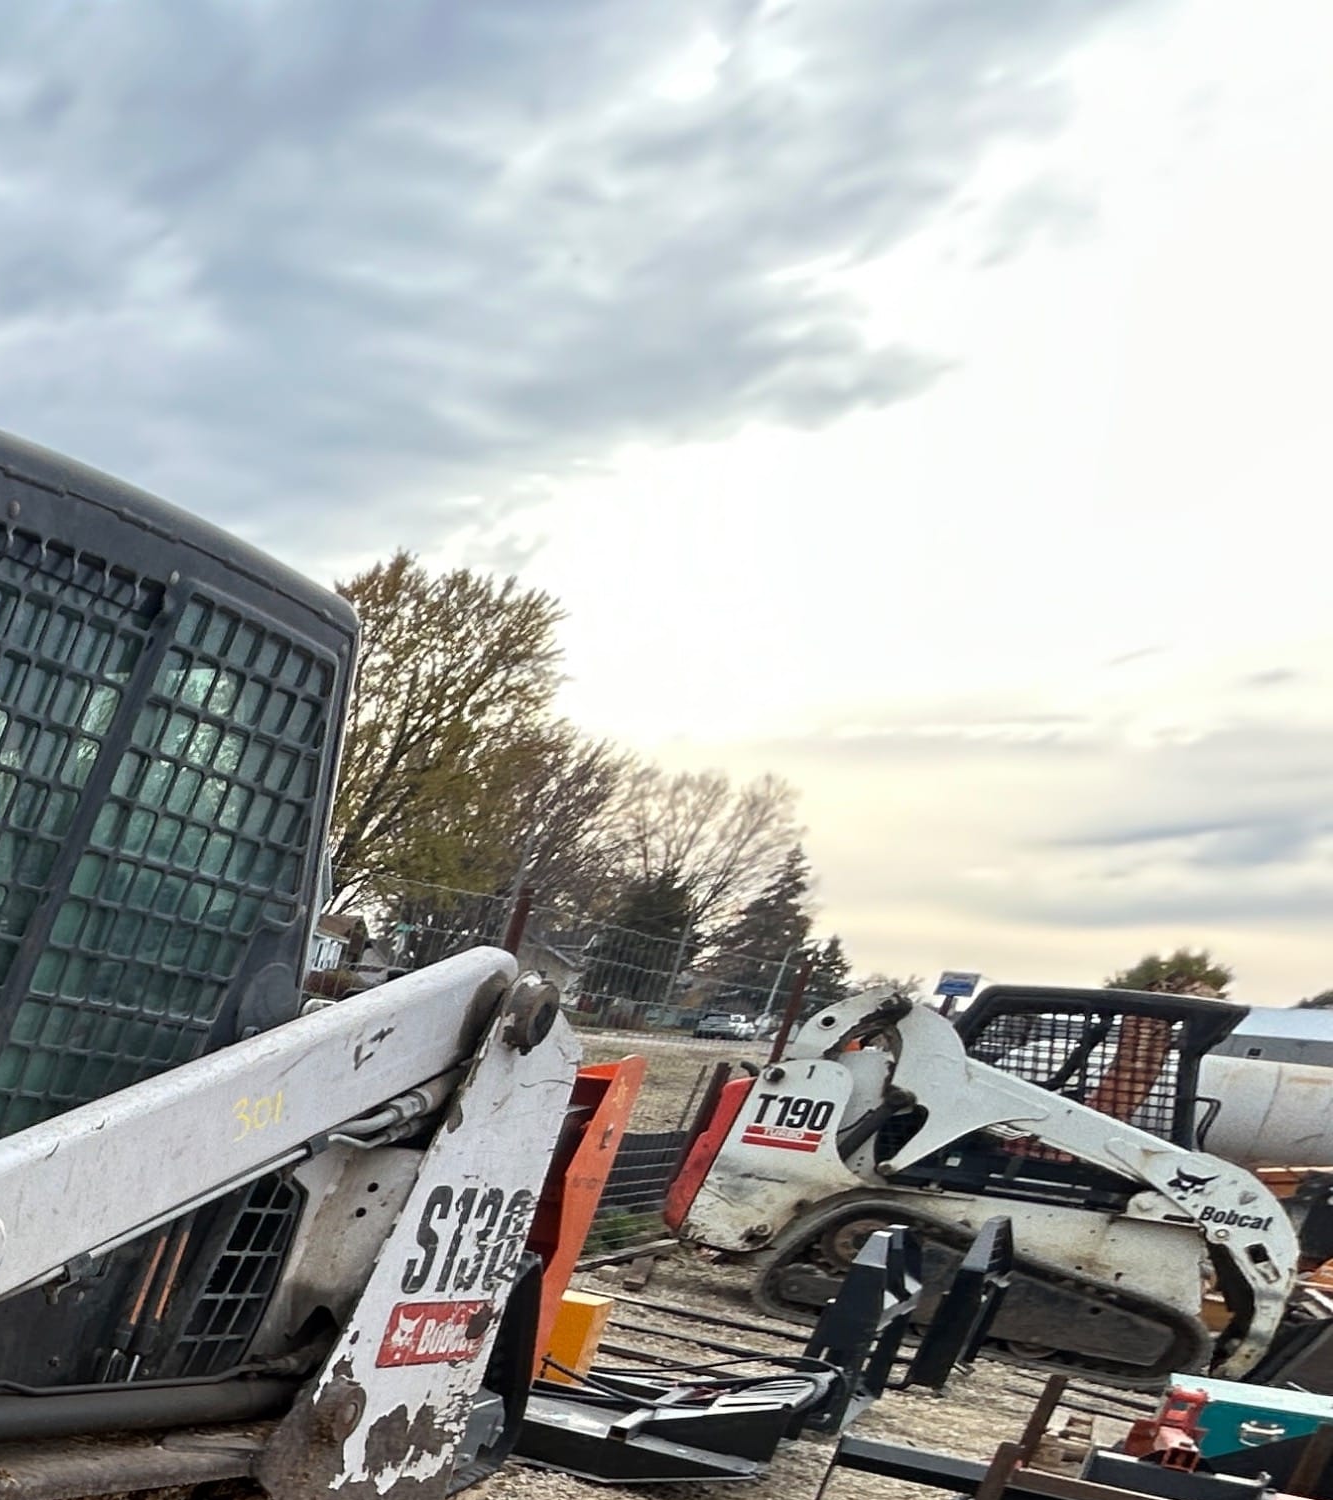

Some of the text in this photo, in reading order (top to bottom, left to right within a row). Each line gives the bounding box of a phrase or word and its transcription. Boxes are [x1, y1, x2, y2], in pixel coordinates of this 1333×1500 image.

[231, 1089, 284, 1142] 301
[753, 1093, 835, 1131] T190
[763, 1127, 806, 1140] TURBO
[1199, 1206, 1274, 1231] Bobcat
